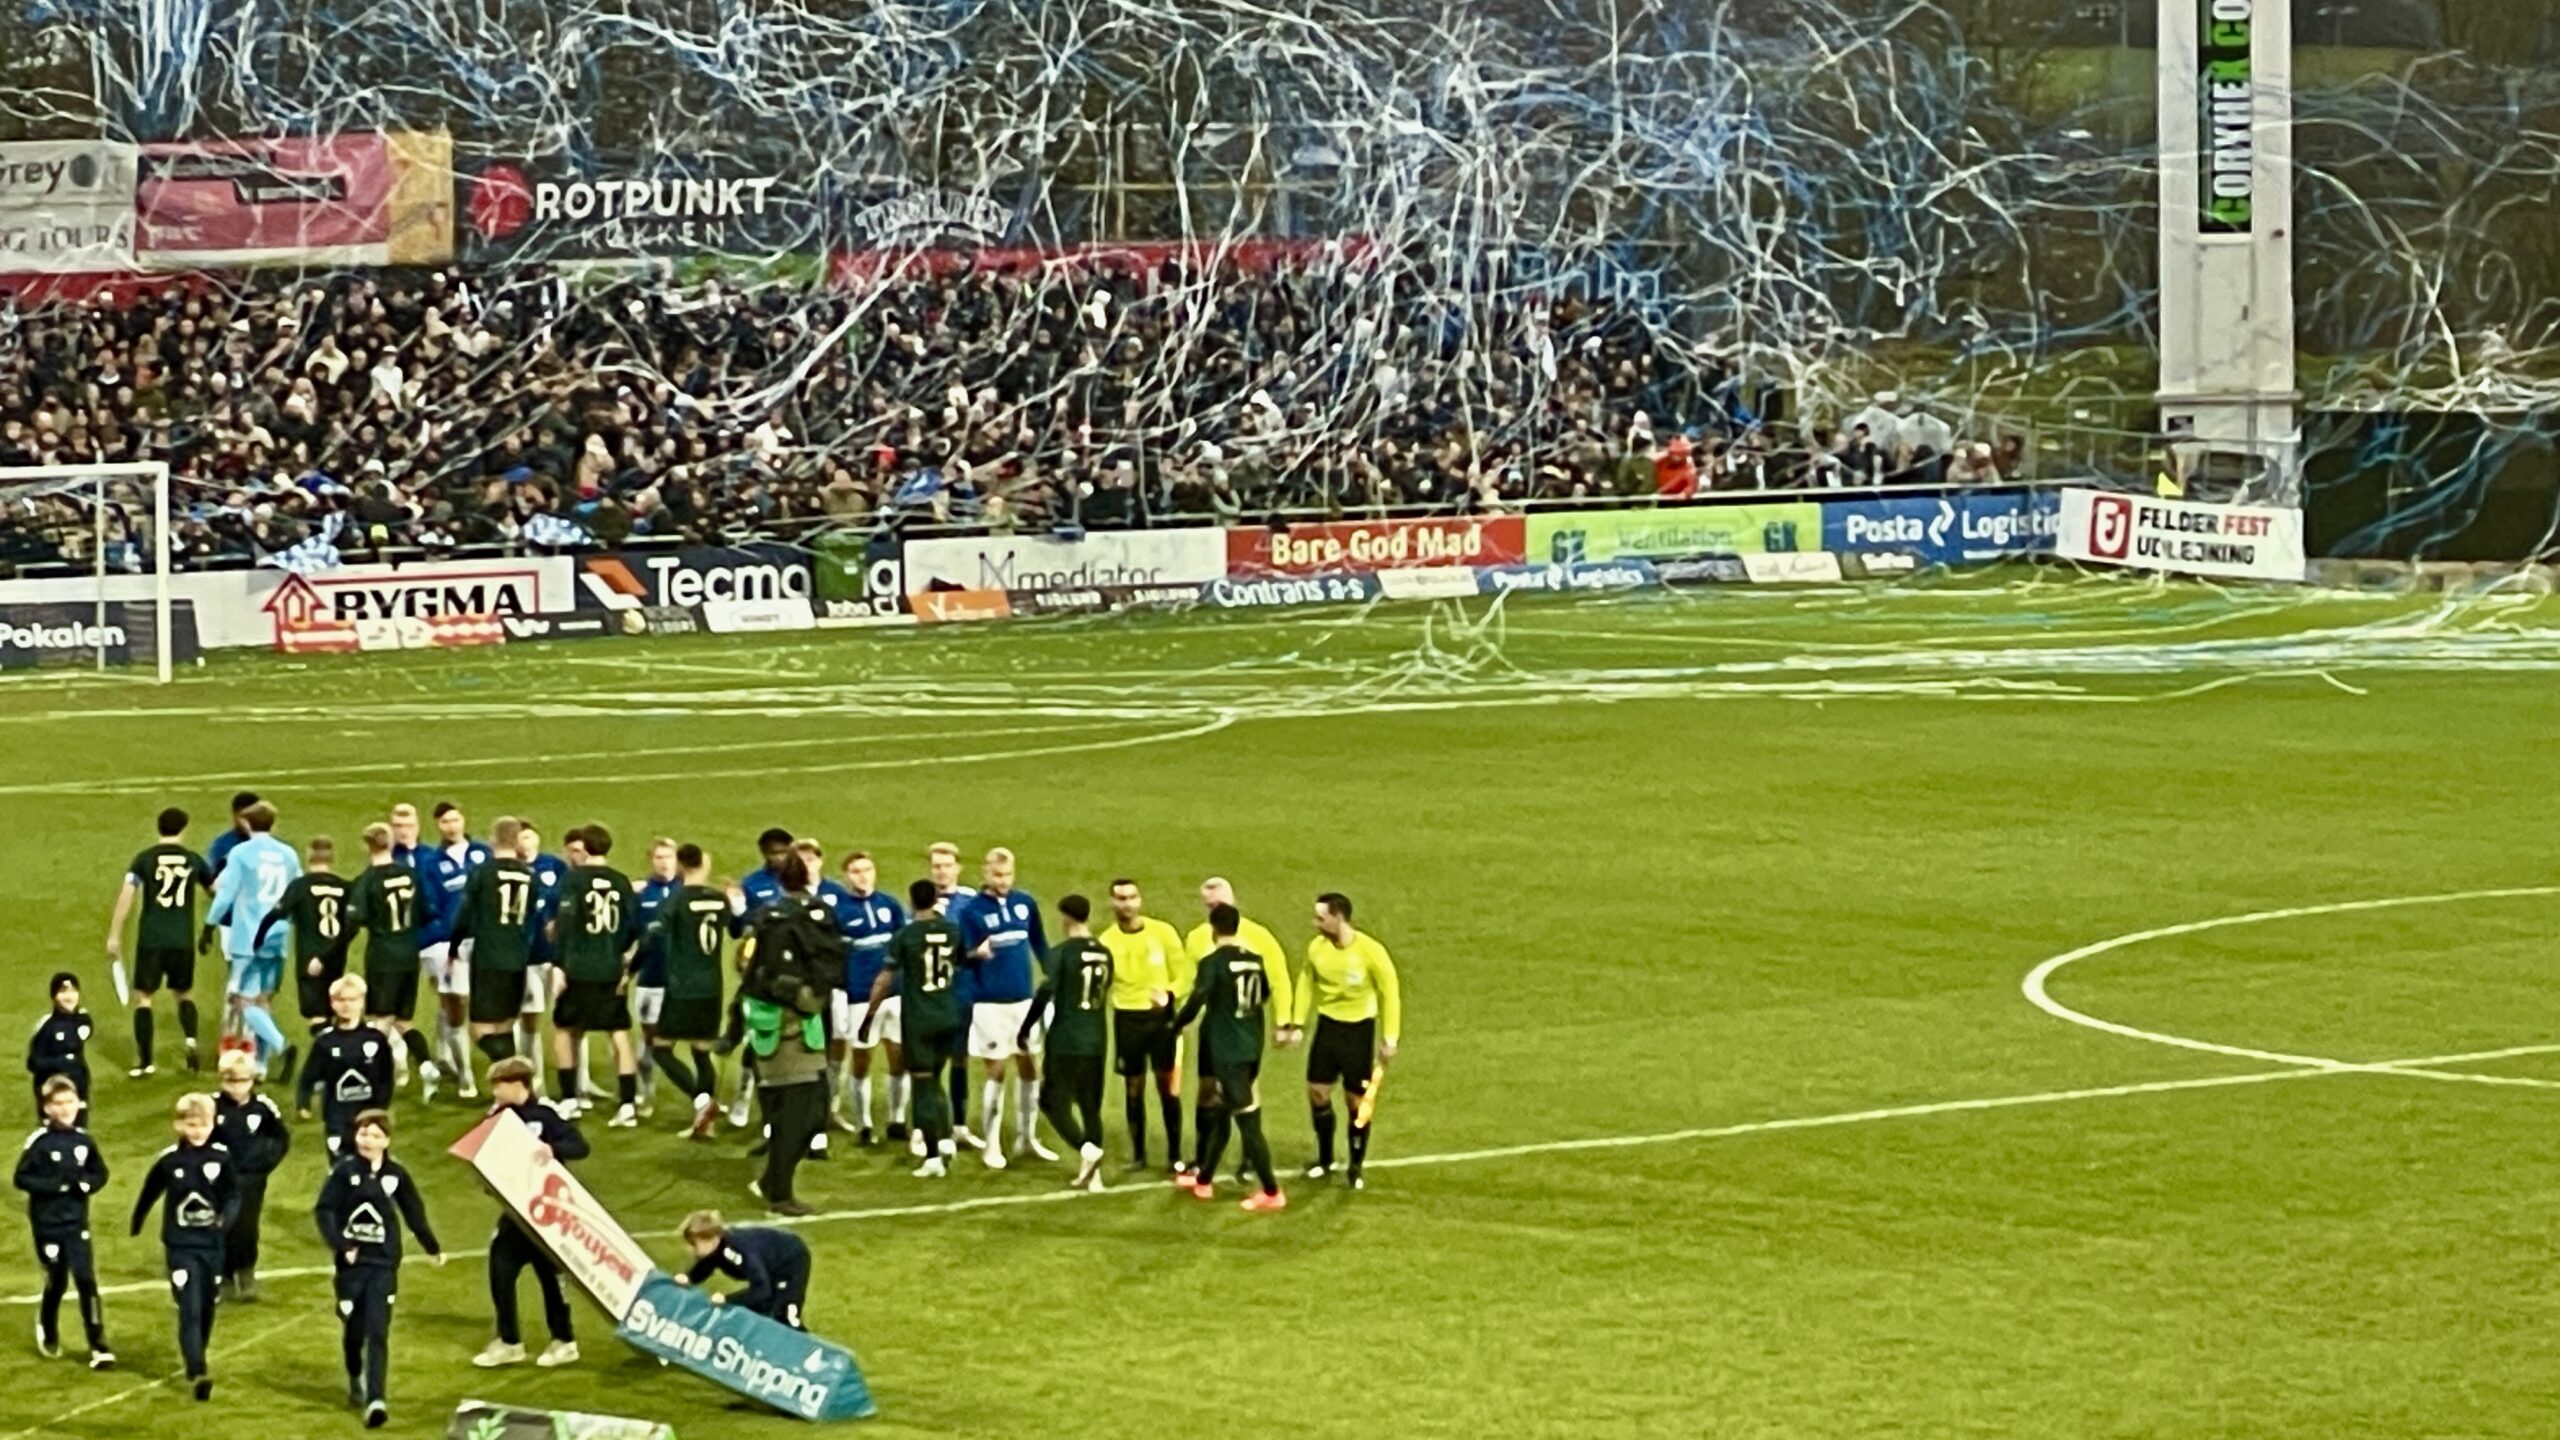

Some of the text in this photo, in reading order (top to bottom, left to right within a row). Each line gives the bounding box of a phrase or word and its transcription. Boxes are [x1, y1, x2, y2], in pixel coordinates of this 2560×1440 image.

[536, 177, 776, 221] ROTPUNKT
[1847, 514, 1923, 543] Posta
[2139, 507, 2272, 536] FELDER FEST
[1271, 523, 1482, 566] Bare God Mad
[1018, 562, 1161, 590] mediator
[1213, 577, 1325, 608] Contrans
[334, 583, 527, 621] RYGMA
[0, 621, 126, 649] Pokalen
[155, 865, 193, 908] 27
[318, 897, 341, 939] 8
[585, 889, 621, 934] 36
[698, 911, 718, 956] 6
[921, 945, 954, 992] 15
[627, 1299, 829, 1418] Svane Shipping
